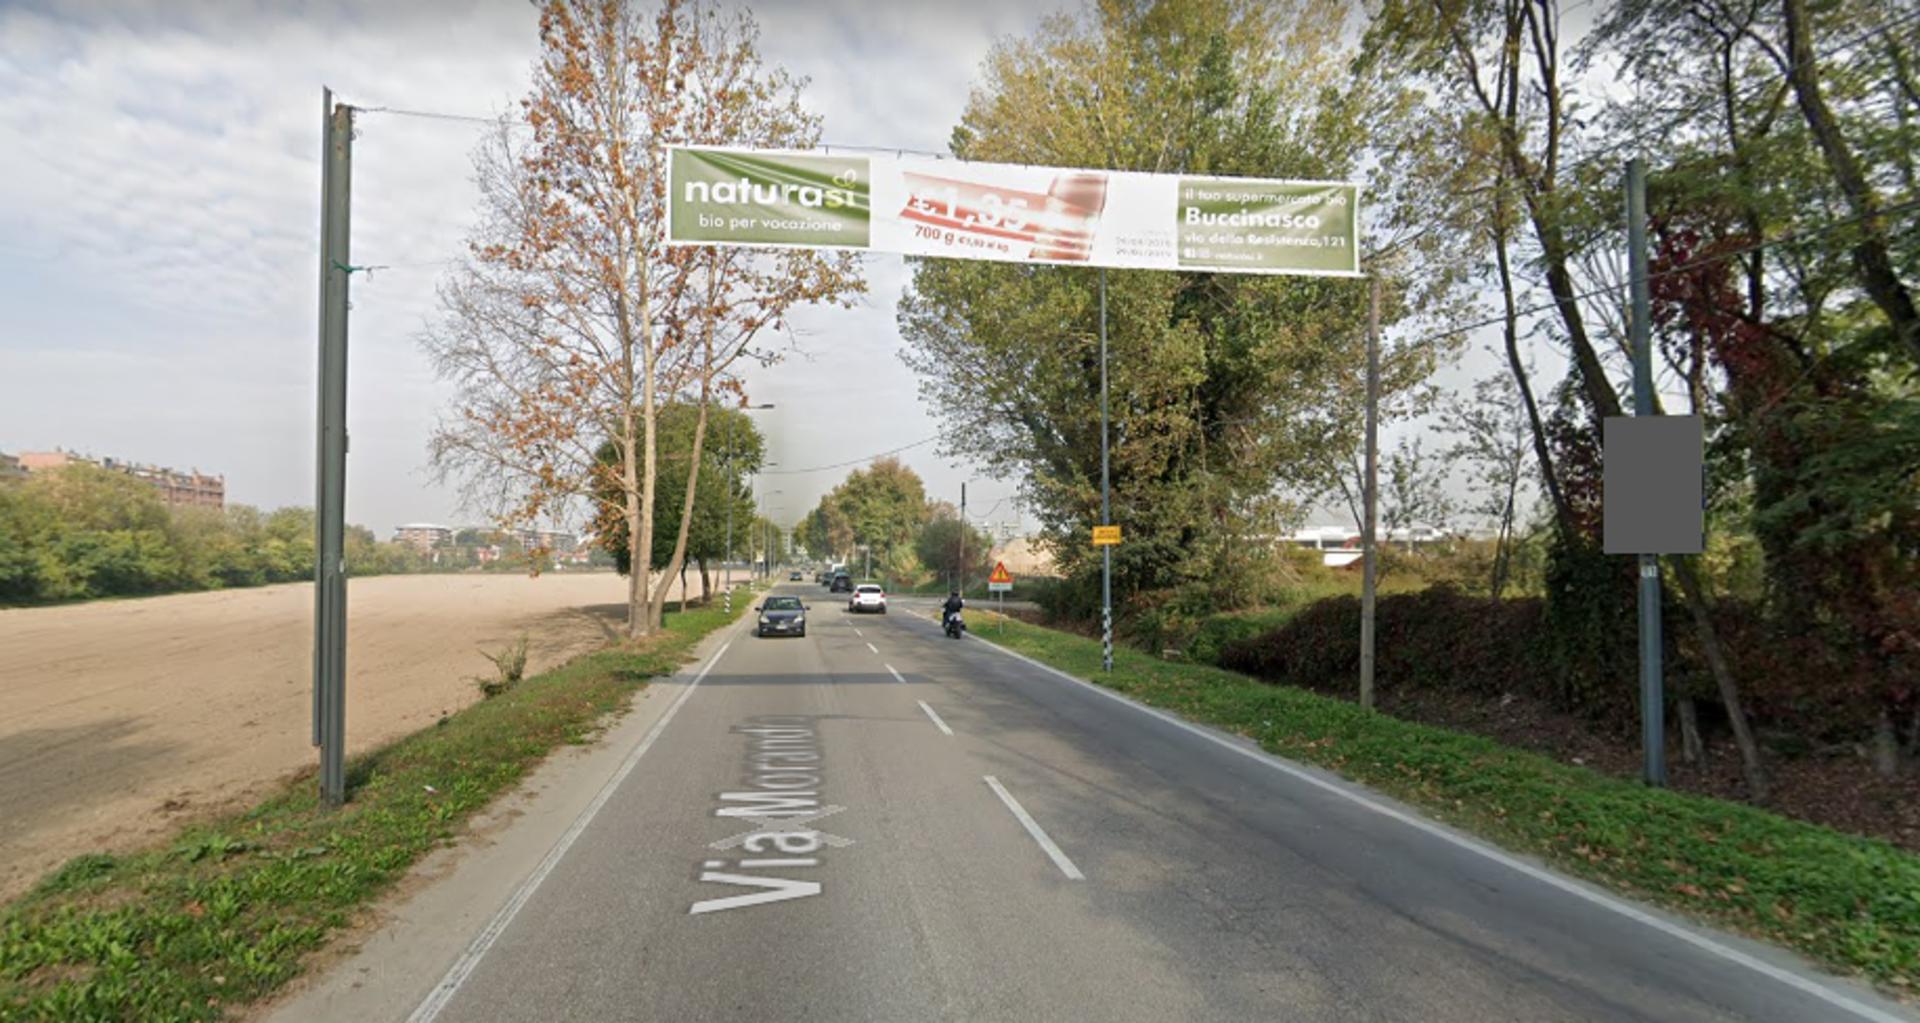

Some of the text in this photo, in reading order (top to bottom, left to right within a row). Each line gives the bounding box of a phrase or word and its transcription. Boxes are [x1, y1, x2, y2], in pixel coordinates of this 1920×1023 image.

[1185, 188, 1347, 206] il tuo supermercato bio
[699, 213, 842, 232] bio per vocazione
[1185, 207, 1321, 229] Buccinasco
[915, 223, 942, 240] 700
[945, 231, 955, 246] g
[1184, 234, 1204, 244] via
[1208, 233, 1244, 245] della
